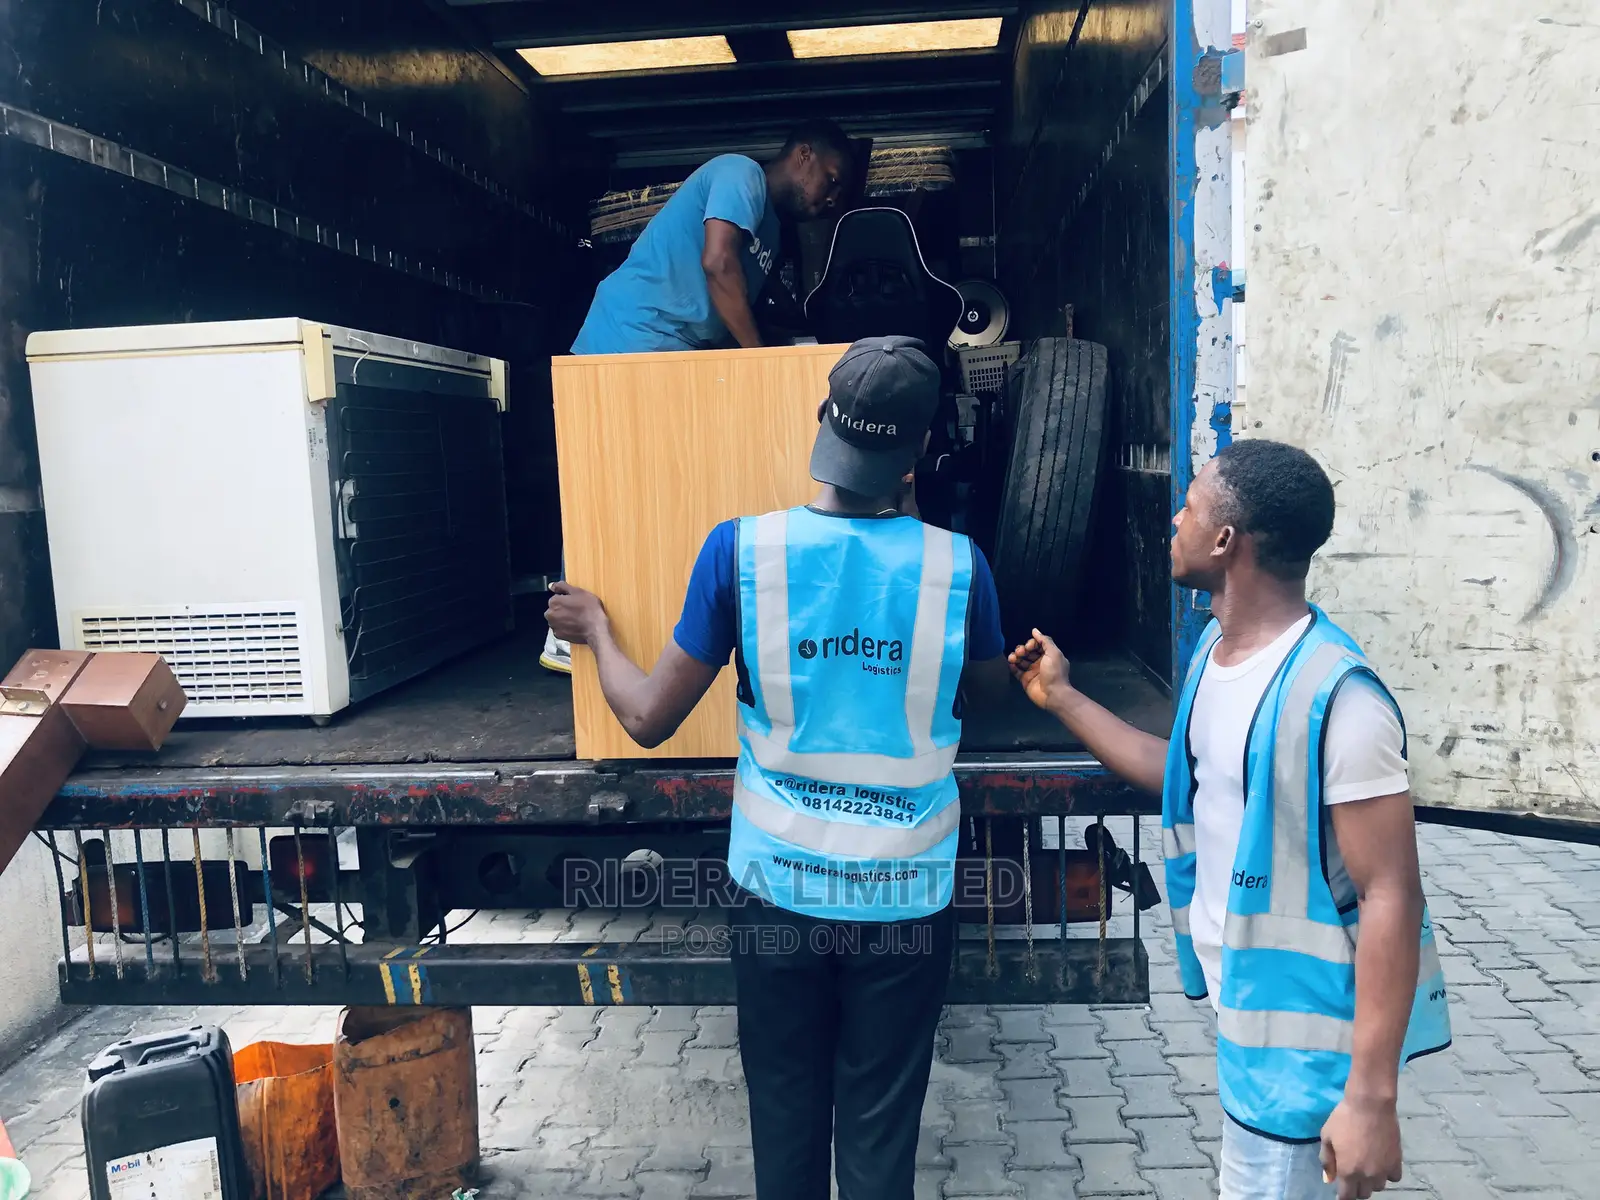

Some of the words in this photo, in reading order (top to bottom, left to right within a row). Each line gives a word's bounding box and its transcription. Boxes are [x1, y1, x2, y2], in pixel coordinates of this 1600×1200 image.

[841, 413, 897, 436] ridera
[822, 627, 903, 662] ridera
[862, 661, 902, 676] Logistics
[802, 796, 914, 823] 08142223841
[772, 854, 918, 884] www.rideralogistics.com
[111, 1159, 141, 1174] Mobil
